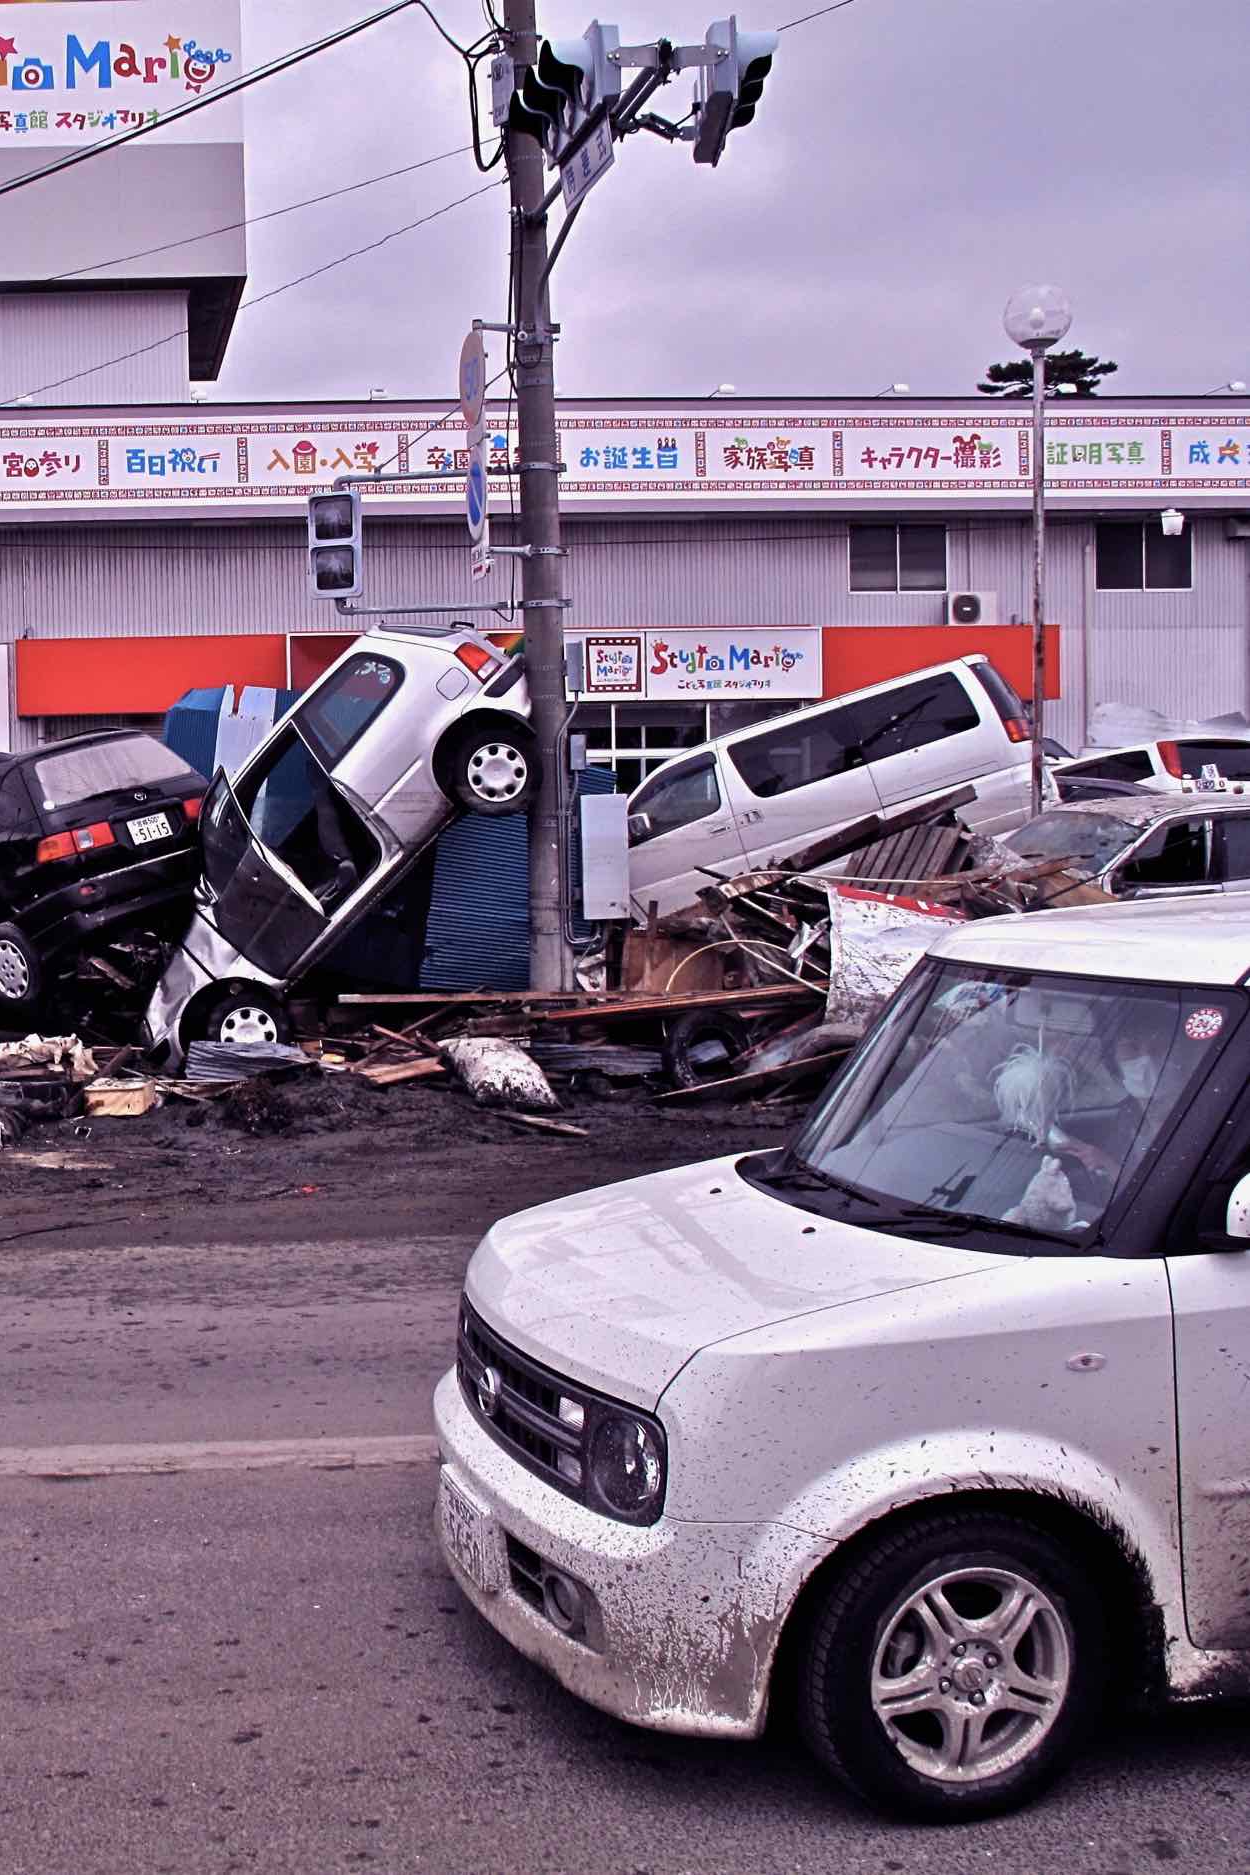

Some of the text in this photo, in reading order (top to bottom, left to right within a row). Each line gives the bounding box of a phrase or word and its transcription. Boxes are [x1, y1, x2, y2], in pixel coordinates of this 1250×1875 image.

[66, 34, 230, 93] Mario
[55, 109, 159, 130] スタジオマリオ
[126, 449, 220, 477] 百日祝い
[580, 443, 678, 469] お誕生日
[723, 445, 815, 472] 家族写真
[861, 441, 1001, 469] キャラクター撮影
[1046, 441, 1145, 465] 証明写真
[1189, 438, 1250, 465] 成人
[649, 641, 803, 674] Studio Mario
